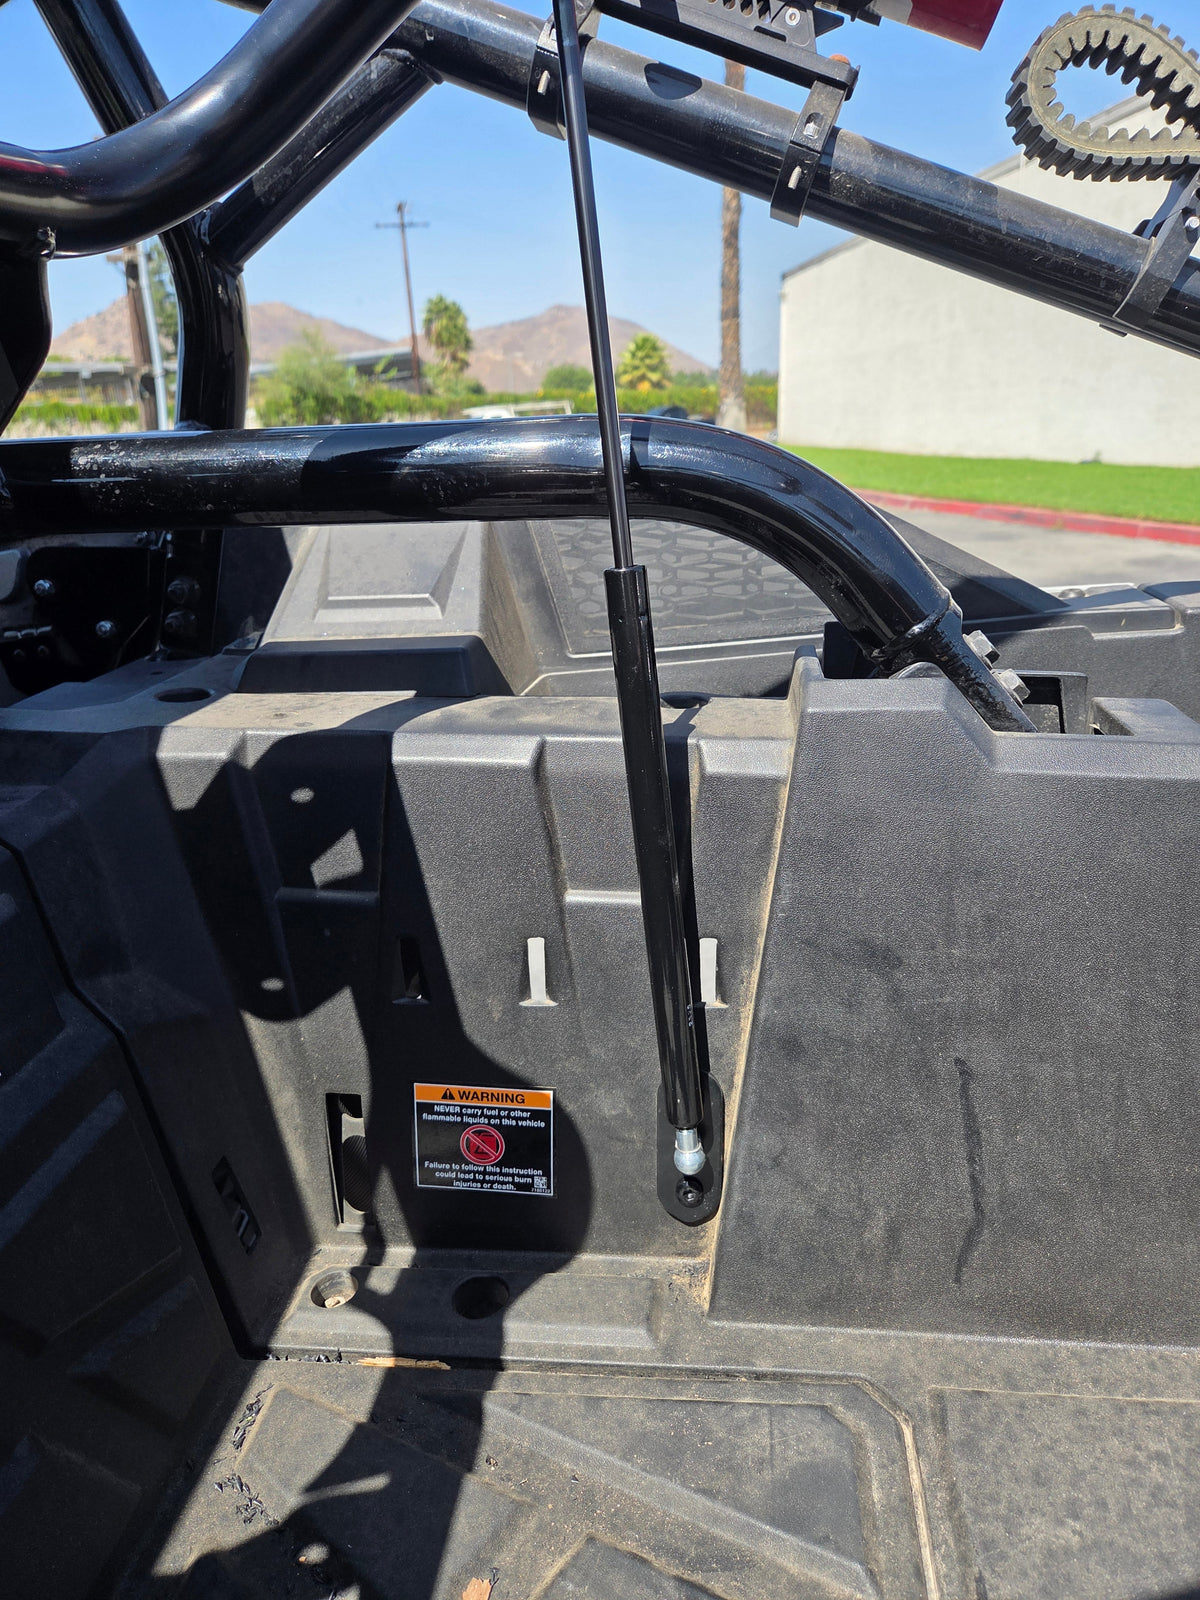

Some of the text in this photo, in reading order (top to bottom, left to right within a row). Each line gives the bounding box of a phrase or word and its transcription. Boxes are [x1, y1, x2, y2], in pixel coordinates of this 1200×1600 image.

[458, 1090, 526, 1104] WARNING
[434, 1105, 461, 1113] NEVER
[462, 1107, 482, 1115] carry
[510, 1110, 531, 1118] other
[422, 1113, 461, 1122] flammable
[463, 1115, 488, 1124] liquids
[502, 1117, 516, 1126] this
[518, 1119, 546, 1128] vehicle
[424, 1161, 543, 1176] Failure to follow this instruction
[435, 1170, 456, 1178] could
[458, 1171, 474, 1179] lead
[485, 1173, 513, 1182] serious
[514, 1175, 532, 1183] burn
[453, 1179, 481, 1188] injuries
[493, 1182, 517, 1190] death.
